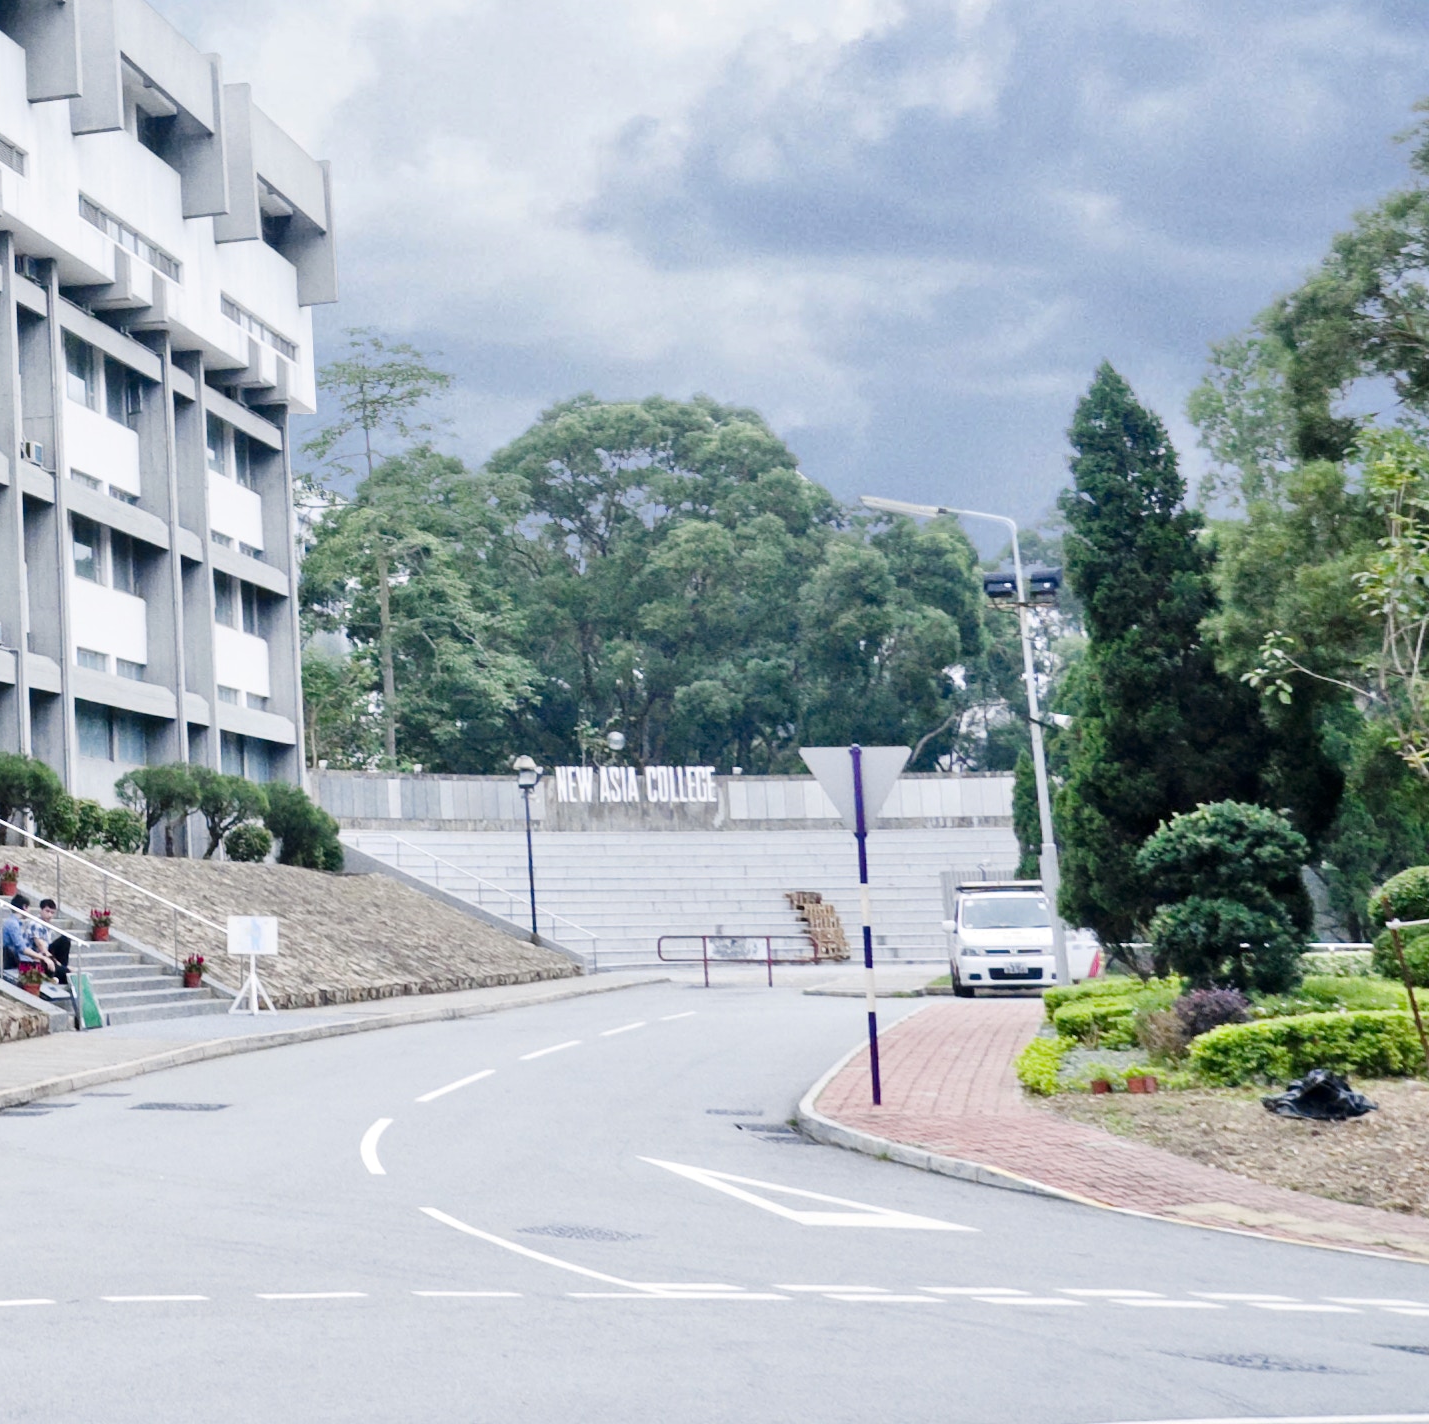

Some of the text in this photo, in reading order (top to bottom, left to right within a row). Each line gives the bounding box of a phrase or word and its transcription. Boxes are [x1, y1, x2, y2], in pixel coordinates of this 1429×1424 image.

[555, 766, 718, 803] NEW ASIA COLLEGE
